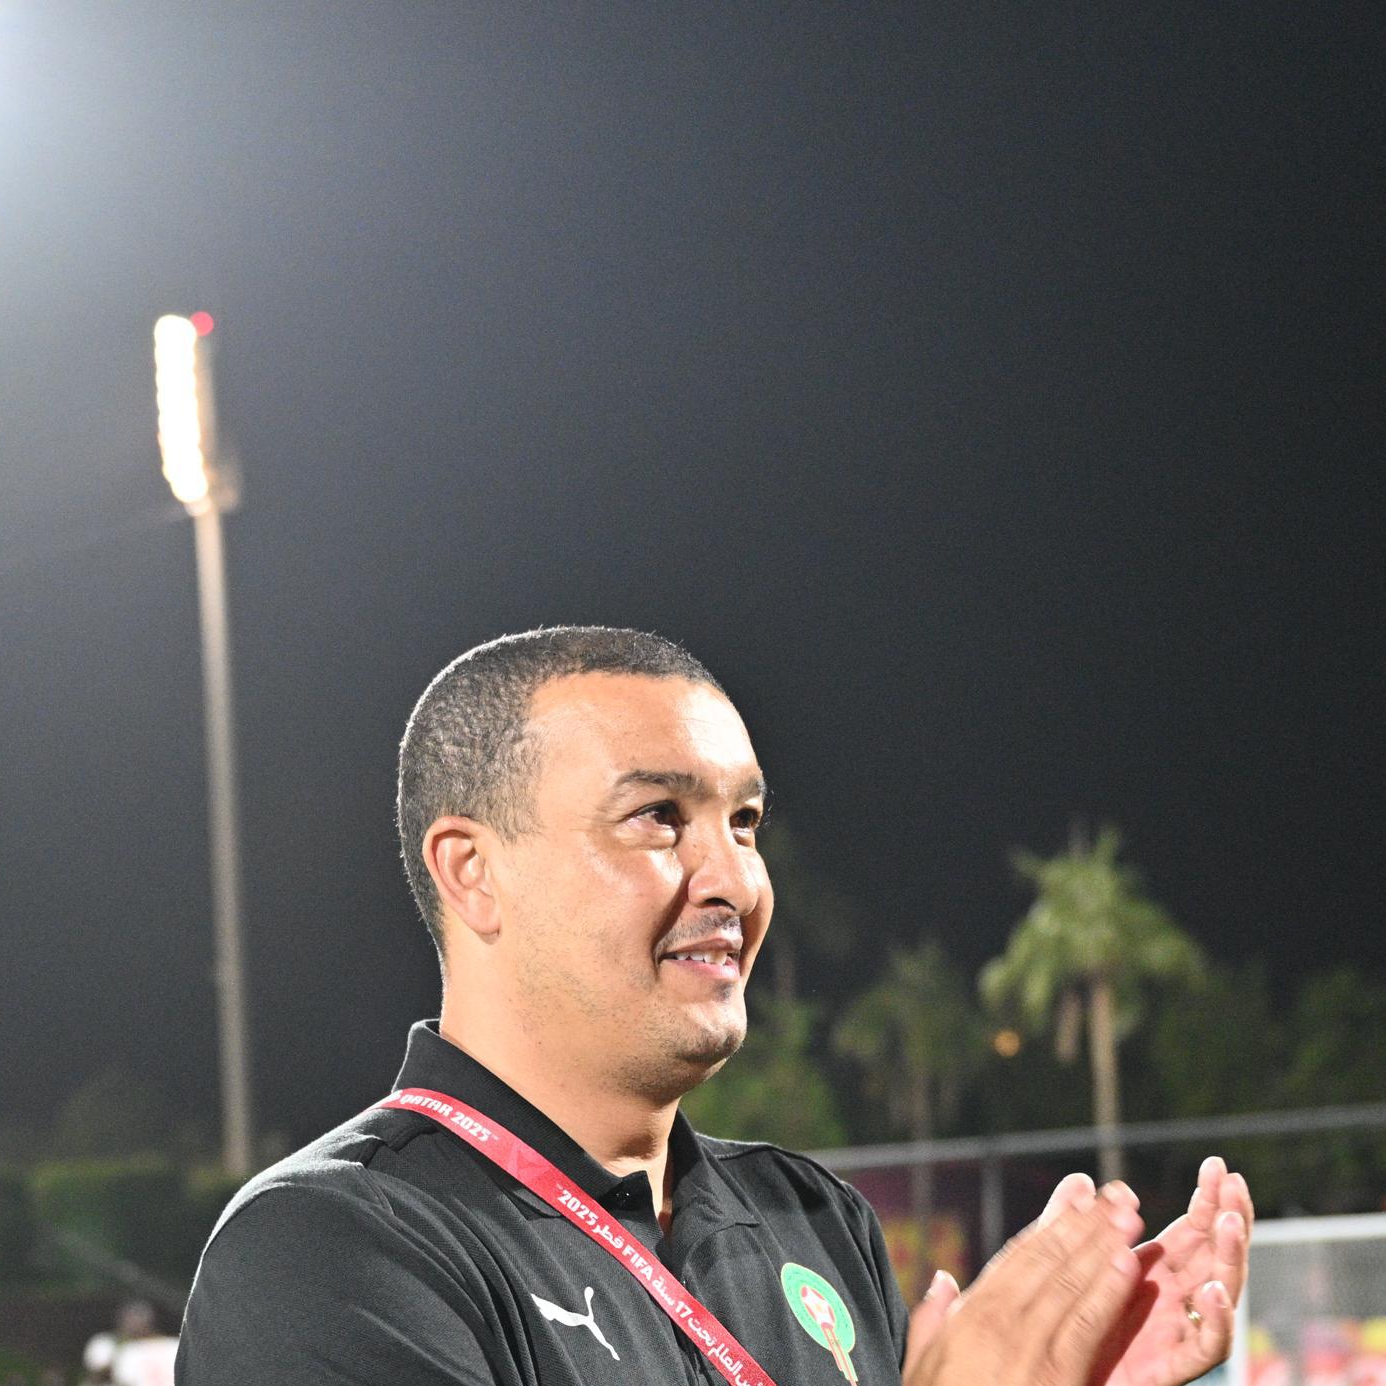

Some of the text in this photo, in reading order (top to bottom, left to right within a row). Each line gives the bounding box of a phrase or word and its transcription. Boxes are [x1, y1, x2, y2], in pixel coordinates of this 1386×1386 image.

[399, 1094, 453, 1117] QATAR
[592, 1225, 625, 1249] قطر
[621, 1244, 654, 1281] FIFA
[675, 1300, 693, 1318] 17
